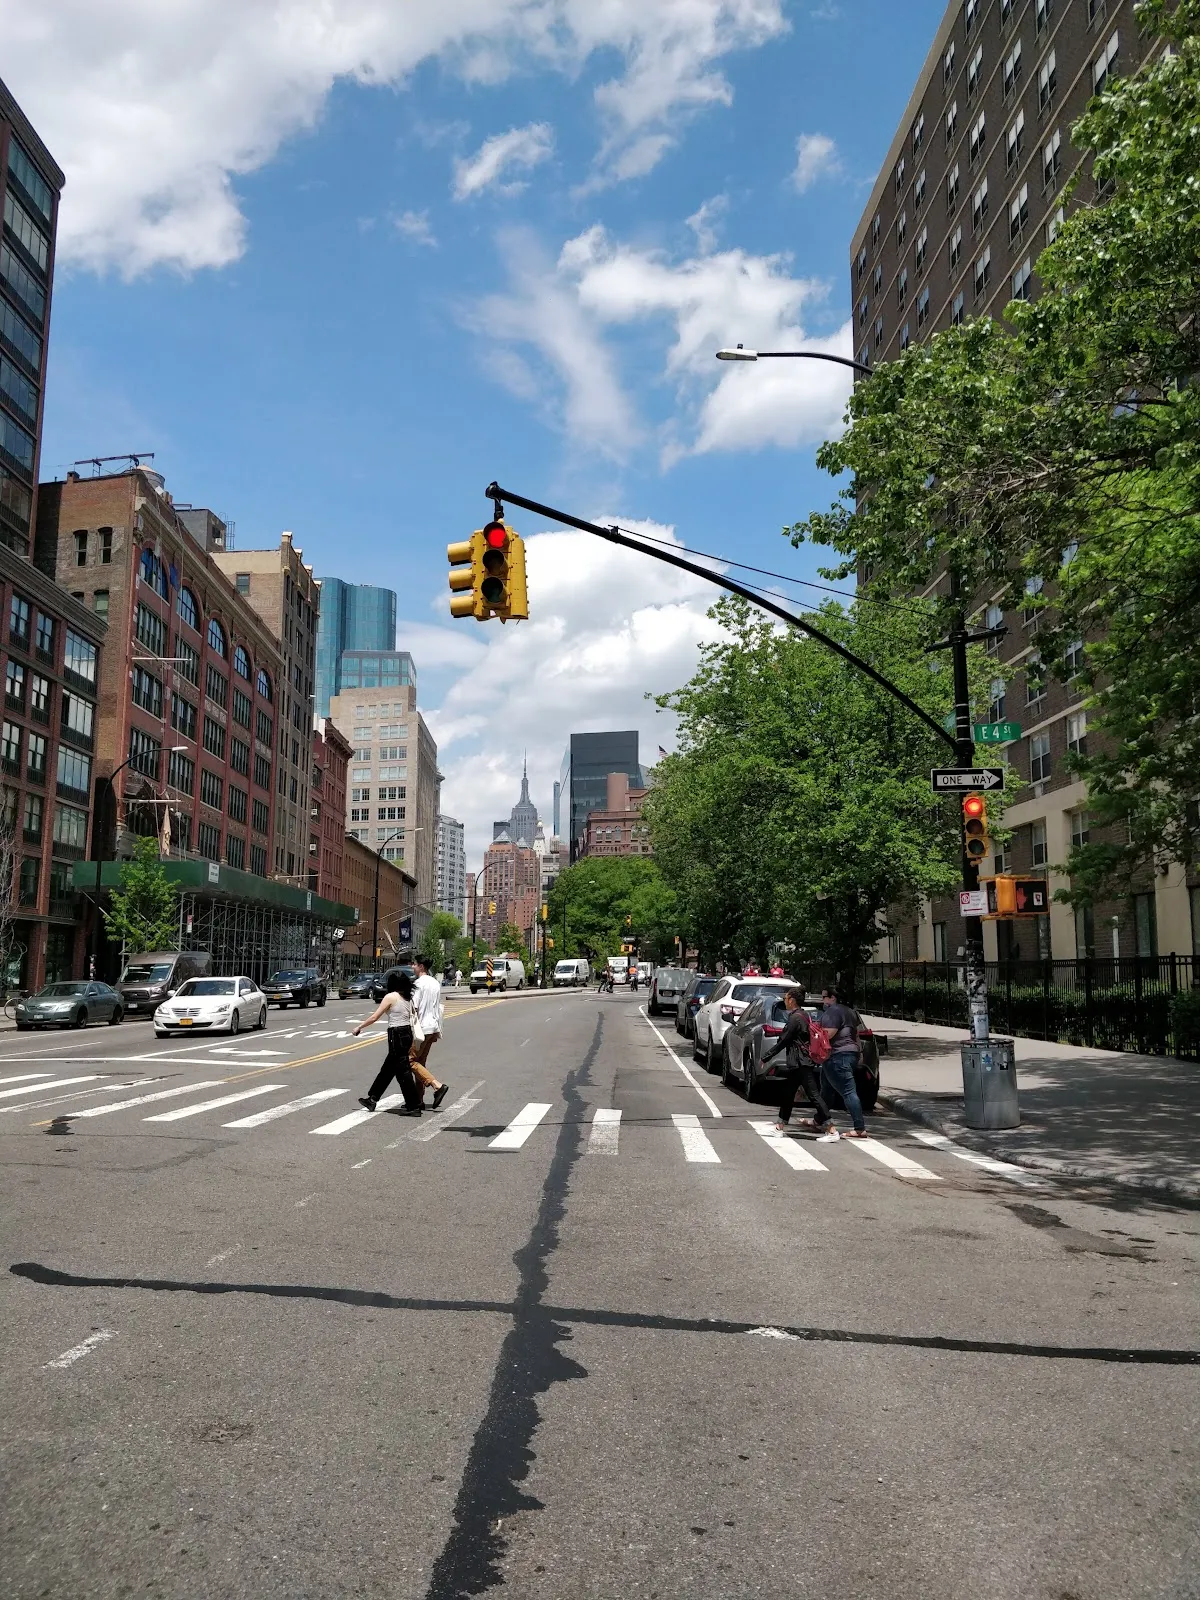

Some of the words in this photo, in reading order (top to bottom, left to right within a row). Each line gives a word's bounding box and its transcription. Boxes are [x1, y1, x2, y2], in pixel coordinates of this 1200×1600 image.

[981, 726, 988, 739] E
[992, 725, 1000, 739] 4
[942, 775, 963, 785] ONE
[971, 775, 993, 784] WAY
